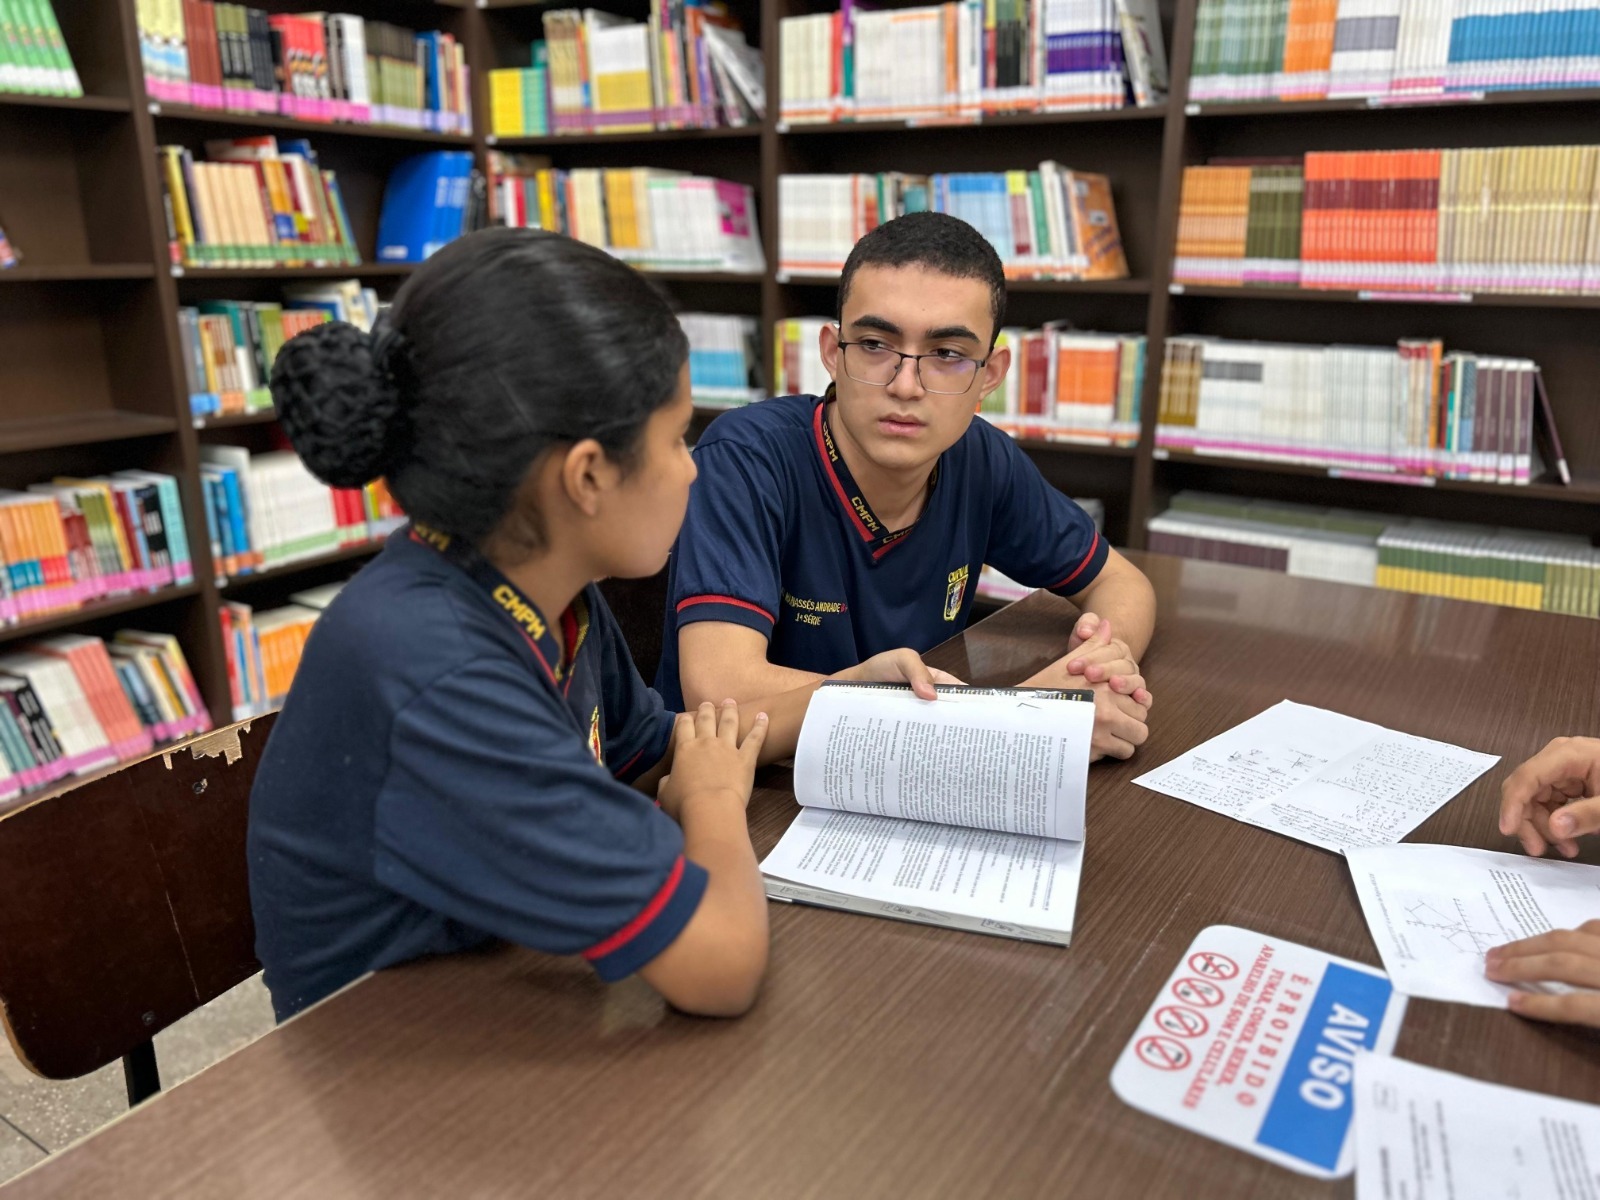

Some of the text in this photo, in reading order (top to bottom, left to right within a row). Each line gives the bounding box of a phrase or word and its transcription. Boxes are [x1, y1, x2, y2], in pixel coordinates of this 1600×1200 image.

[851, 496, 880, 532] CMPM
[493, 585, 546, 640] CMPM
[803, 613, 822, 626] SÉRIE
[814, 601, 841, 614] ANDRADE
[1256, 968, 1285, 1005] FUMAR,
[1182, 944, 1275, 1110] APARELHO DE SOM E CELULARES
[1235, 973, 1313, 1108] É PROIBIDO
[1236, 1006, 1266, 1044] COMER,
[1299, 1002, 1370, 1110] AVISO
